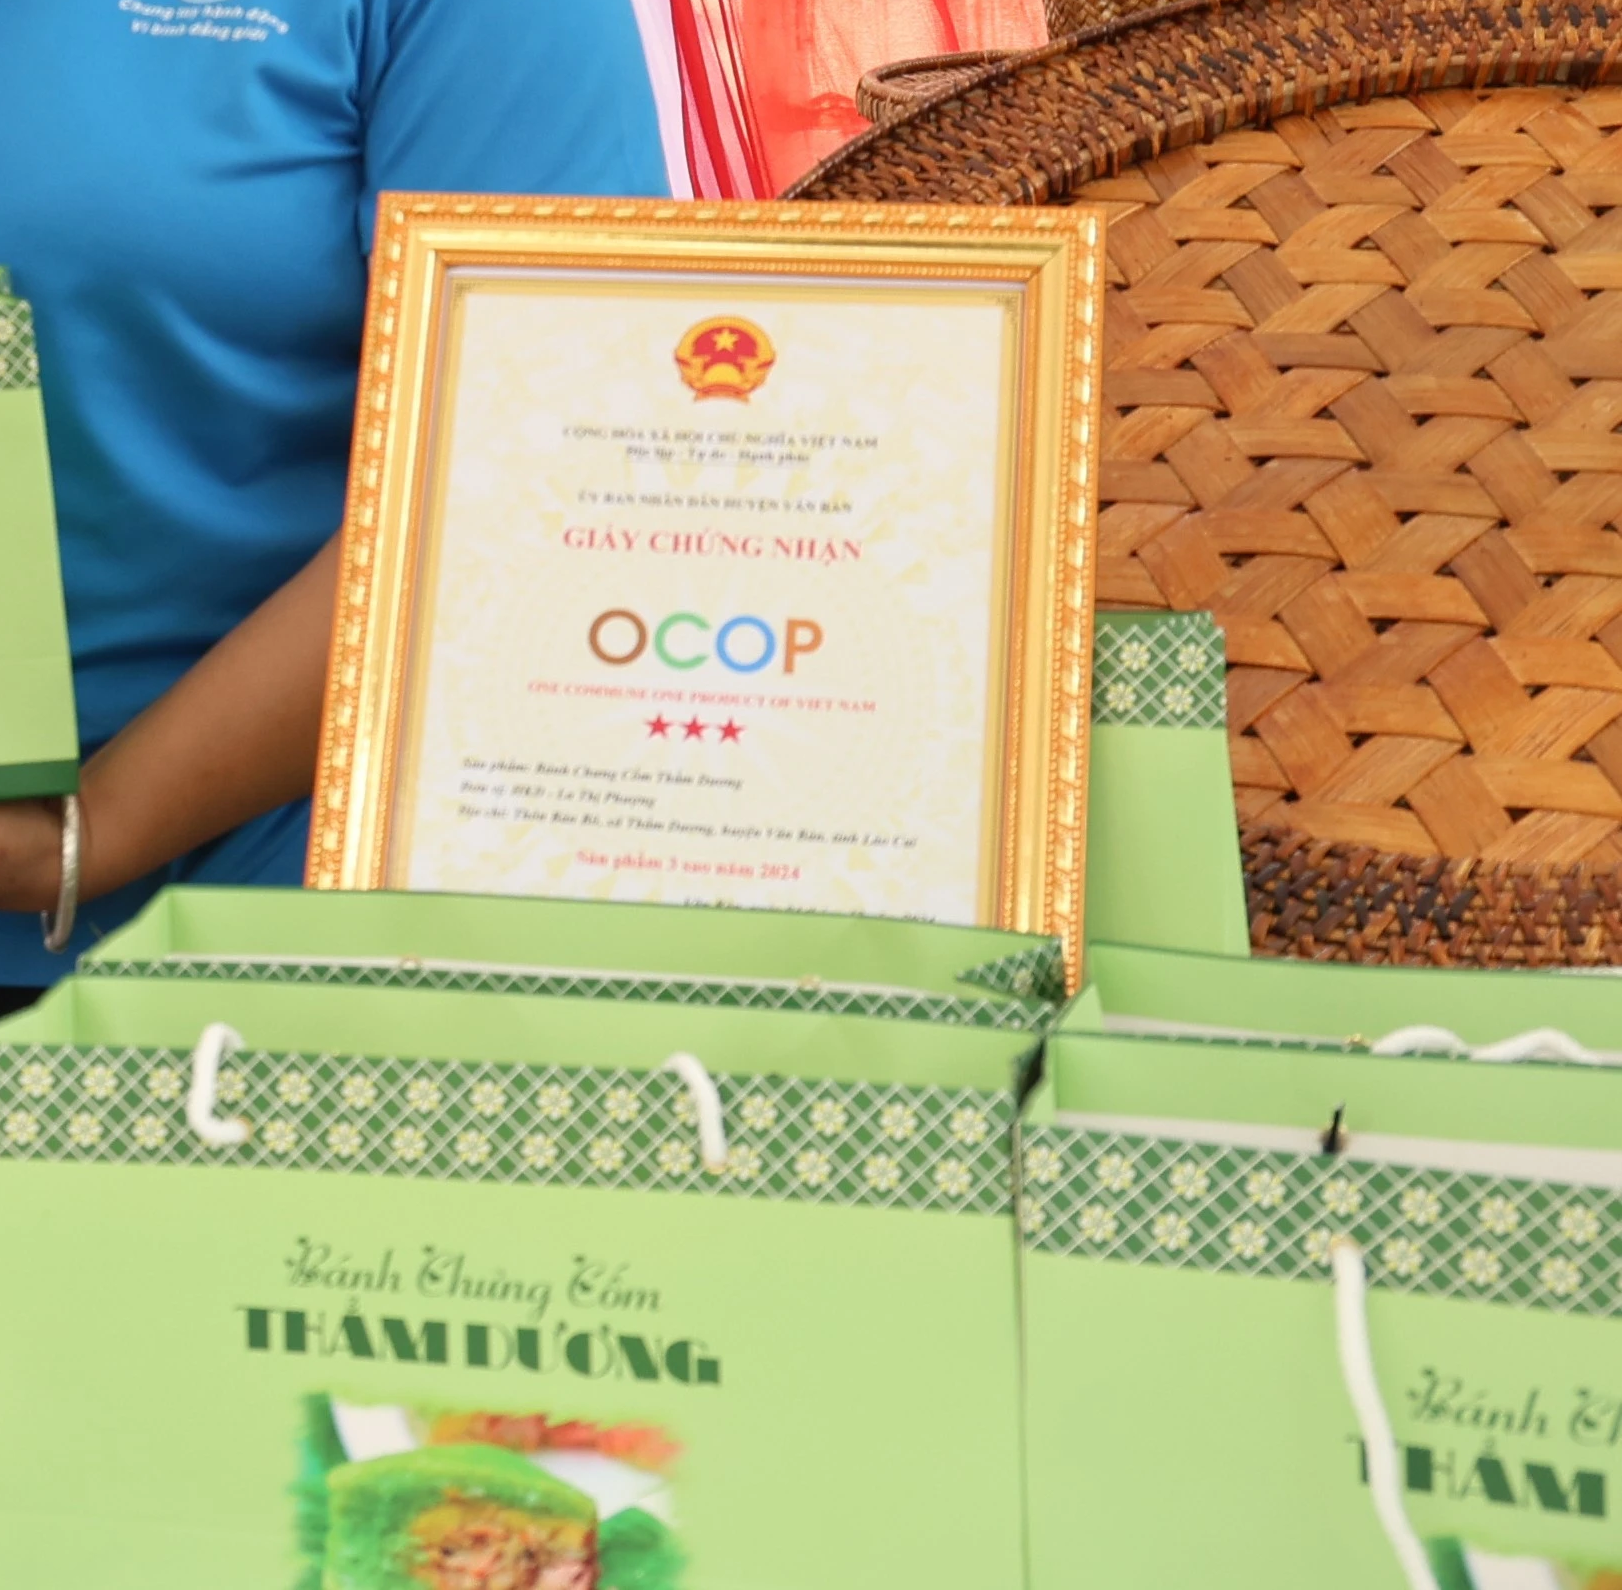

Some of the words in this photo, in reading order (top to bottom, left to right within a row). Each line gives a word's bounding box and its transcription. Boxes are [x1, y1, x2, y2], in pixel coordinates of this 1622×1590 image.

[563, 524, 639, 551] GIẤY
[649, 526, 762, 558] CHỨNG
[773, 535, 863, 566] NHẬN
[588, 608, 824, 675] OCOP
[464, 1320, 723, 1386] DƯƠNG
